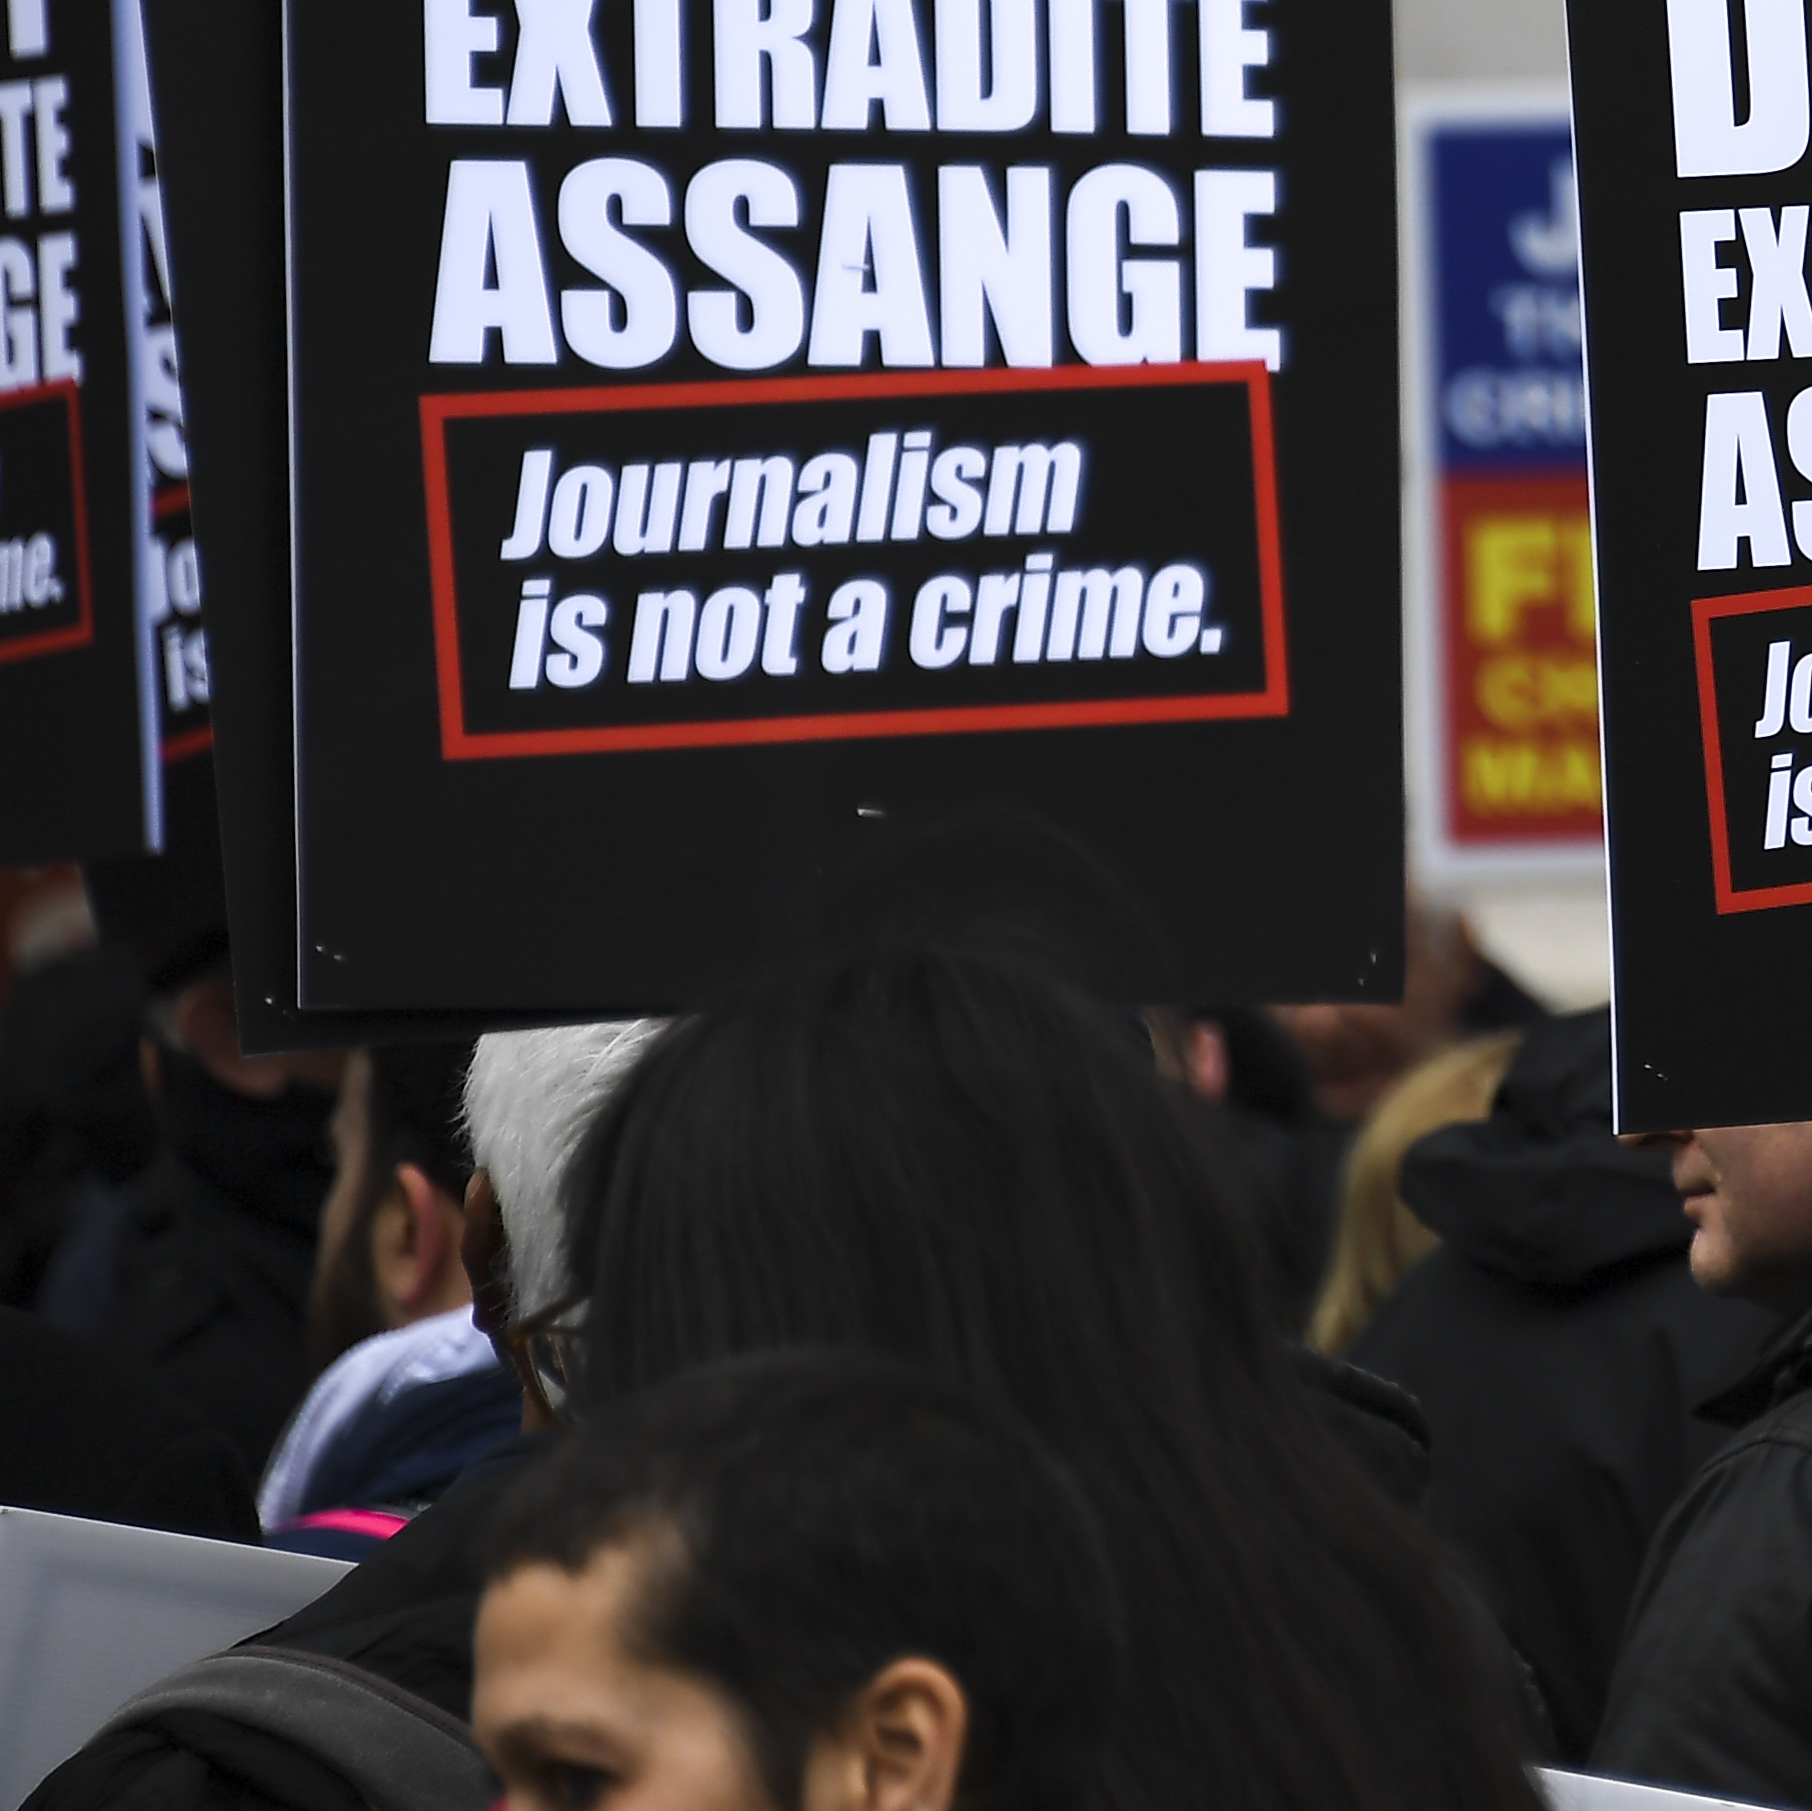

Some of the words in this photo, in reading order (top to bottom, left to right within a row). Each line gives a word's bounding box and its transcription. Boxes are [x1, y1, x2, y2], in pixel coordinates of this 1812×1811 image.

[429, 158, 1281, 372] ASSANGE
[501, 431, 1081, 559] Journalism
[510, 579, 607, 688] is
[628, 573, 806, 682] not
[822, 579, 887, 673] a
[910, 553, 1222, 668] crime.
